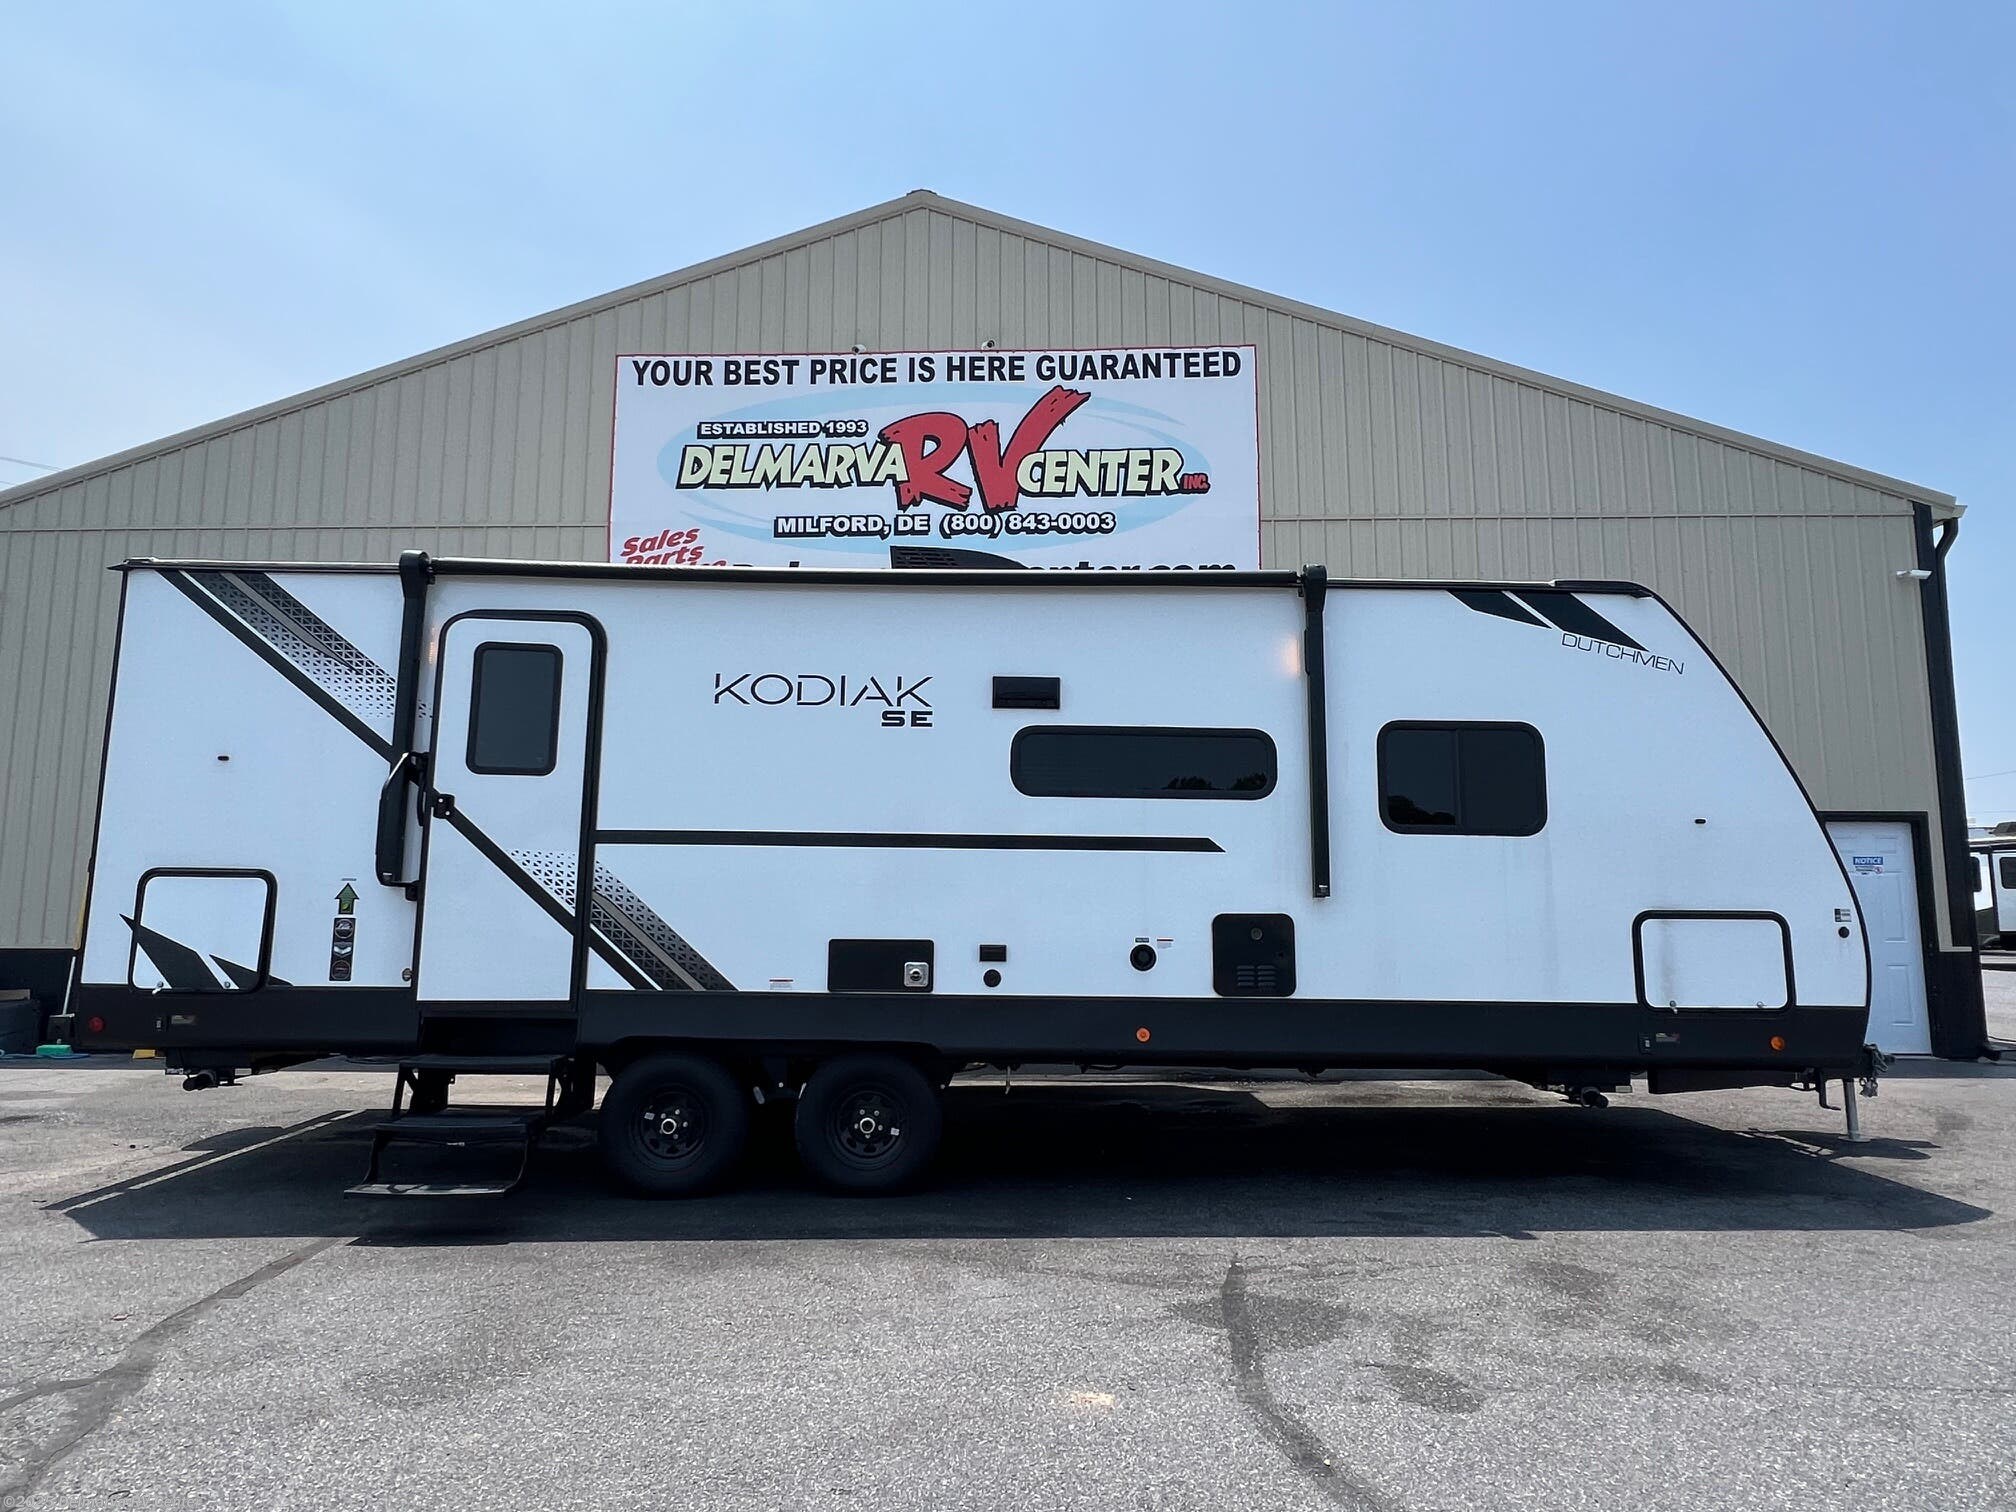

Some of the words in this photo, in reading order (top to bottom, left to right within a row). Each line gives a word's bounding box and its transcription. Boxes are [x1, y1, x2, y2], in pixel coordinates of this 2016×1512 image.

[632, 359, 713, 387] YOUR
[724, 359, 800, 386] BEST
[809, 357, 897, 385] PRICE
[909, 356, 936, 383] IS
[946, 355, 1025, 382] HERE
[1036, 351, 1241, 381] GUARANTEED
[699, 421, 821, 436] ESTABLISHED
[825, 421, 868, 434] 1993
[678, 443, 910, 487] DELMARVA
[880, 385, 1092, 512] RV
[1017, 448, 1183, 493] CENTER
[777, 516, 890, 535] MILFORD,
[897, 515, 930, 532] DE
[943, 514, 1001, 534] (800)
[1009, 513, 1115, 531] 843-0003
[620, 528, 700, 556] Sales
[1562, 633, 1685, 675] DUTCHMEN
[713, 673, 933, 707] KODIAK
[881, 710, 933, 727] SE
[1855, 857, 1881, 865] NOTICE
